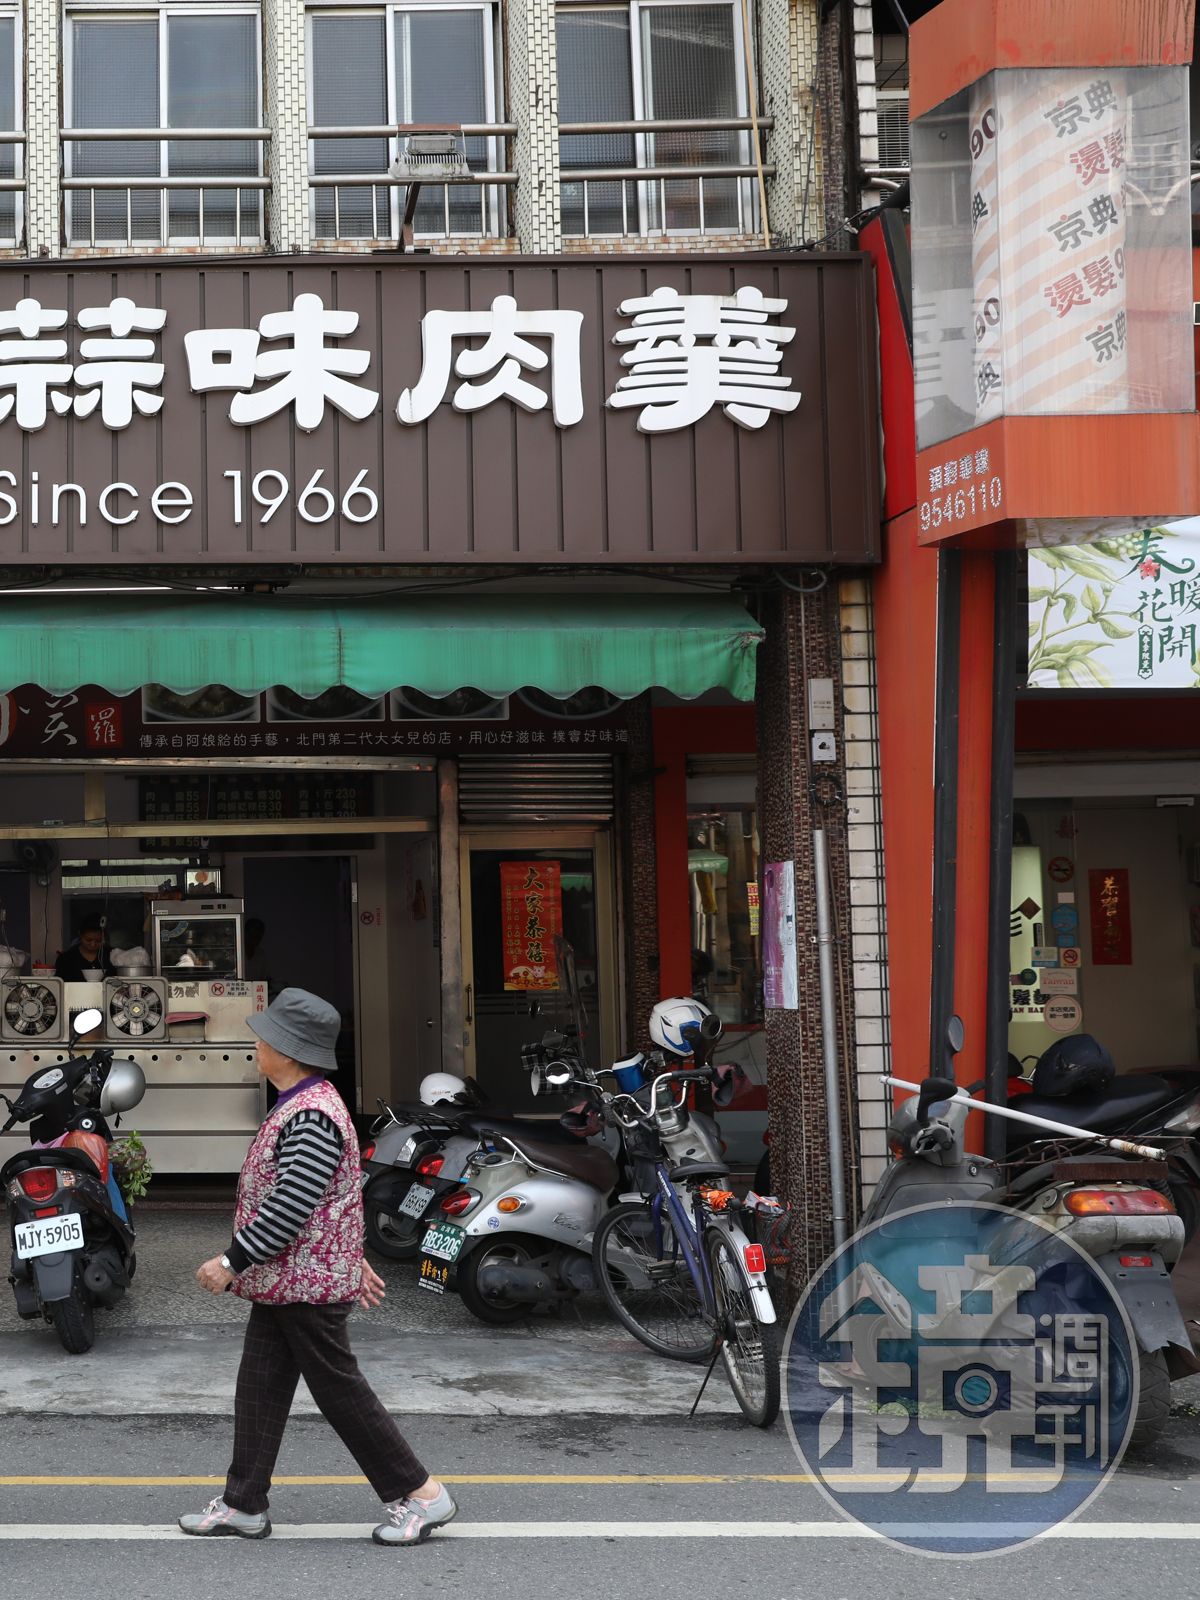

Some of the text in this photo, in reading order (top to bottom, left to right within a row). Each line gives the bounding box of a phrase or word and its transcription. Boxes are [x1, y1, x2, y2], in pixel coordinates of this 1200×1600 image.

[1045, 79, 1118, 138] 京典
[1047, 193, 1118, 252] 京典
[223, 469, 379, 526] 1966
[920, 477, 1001, 530] 9546110
